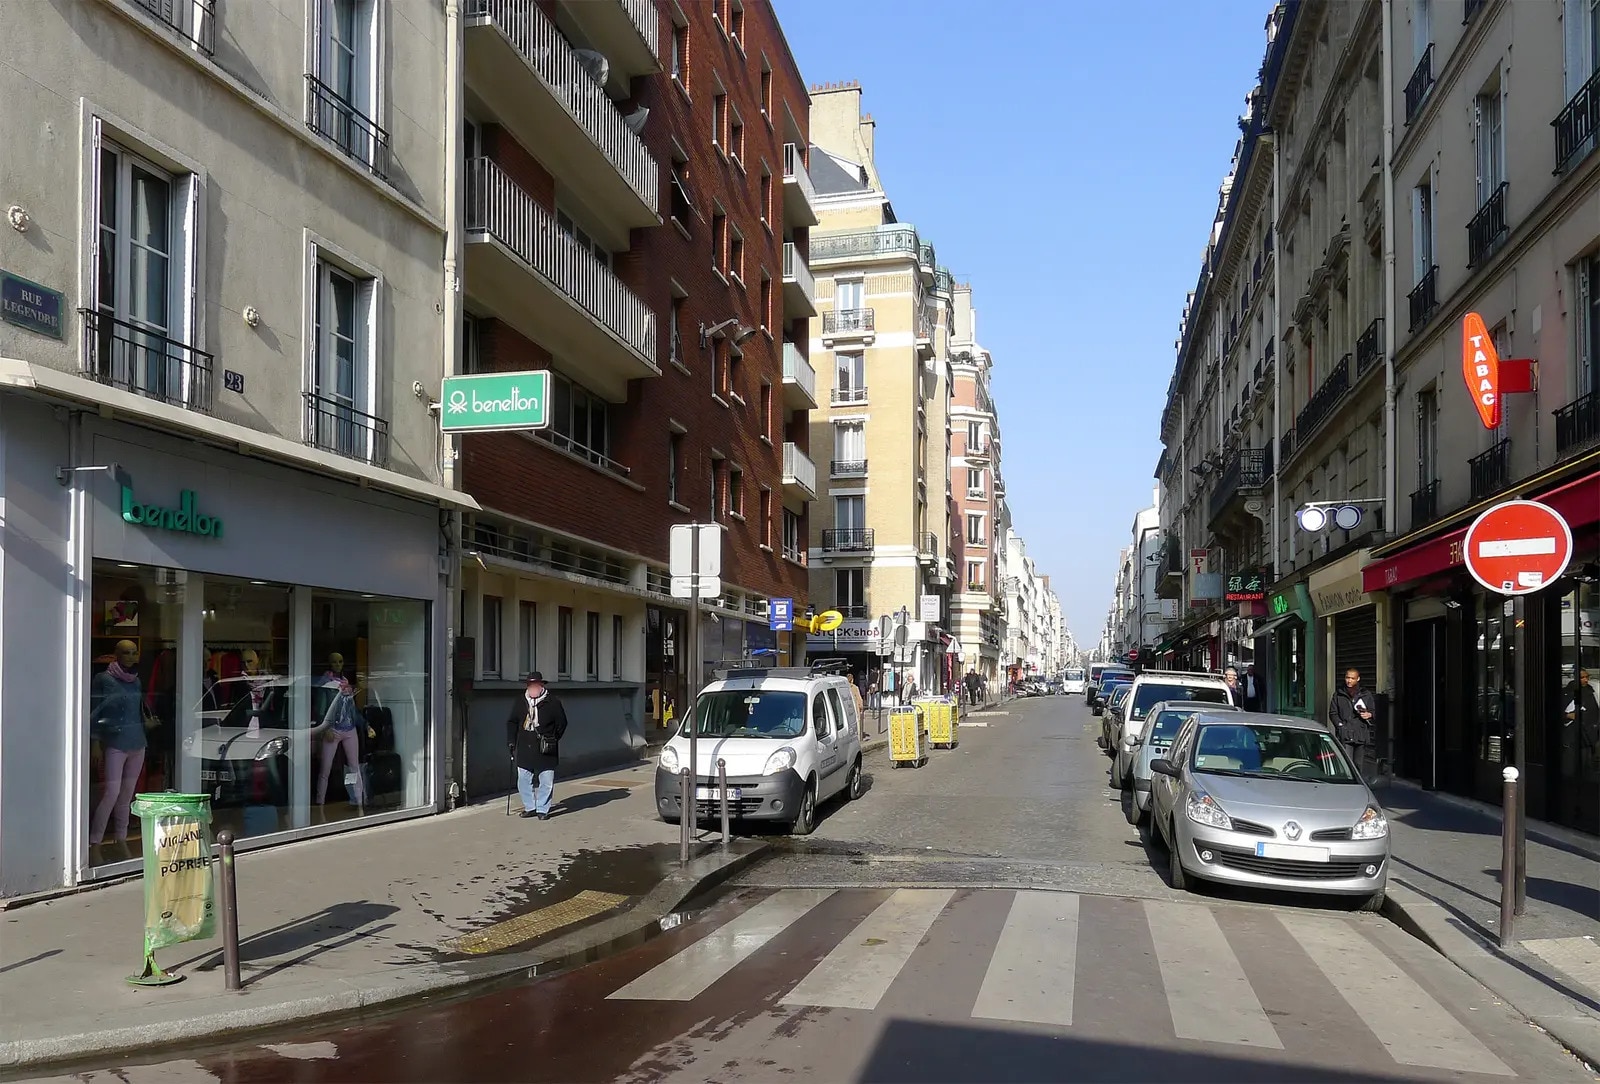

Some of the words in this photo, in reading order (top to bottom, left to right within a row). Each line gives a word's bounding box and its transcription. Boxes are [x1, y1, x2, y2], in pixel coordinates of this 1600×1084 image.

[21, 289, 42, 306] RUE
[4, 299, 58, 327] LEGENDRE
[226, 372, 242, 391] 93
[1469, 335, 1495, 406] TABAC
[472, 387, 538, 413] benetton
[121, 481, 223, 538] benetton
[1226, 593, 1264, 601] RESTAURANT
